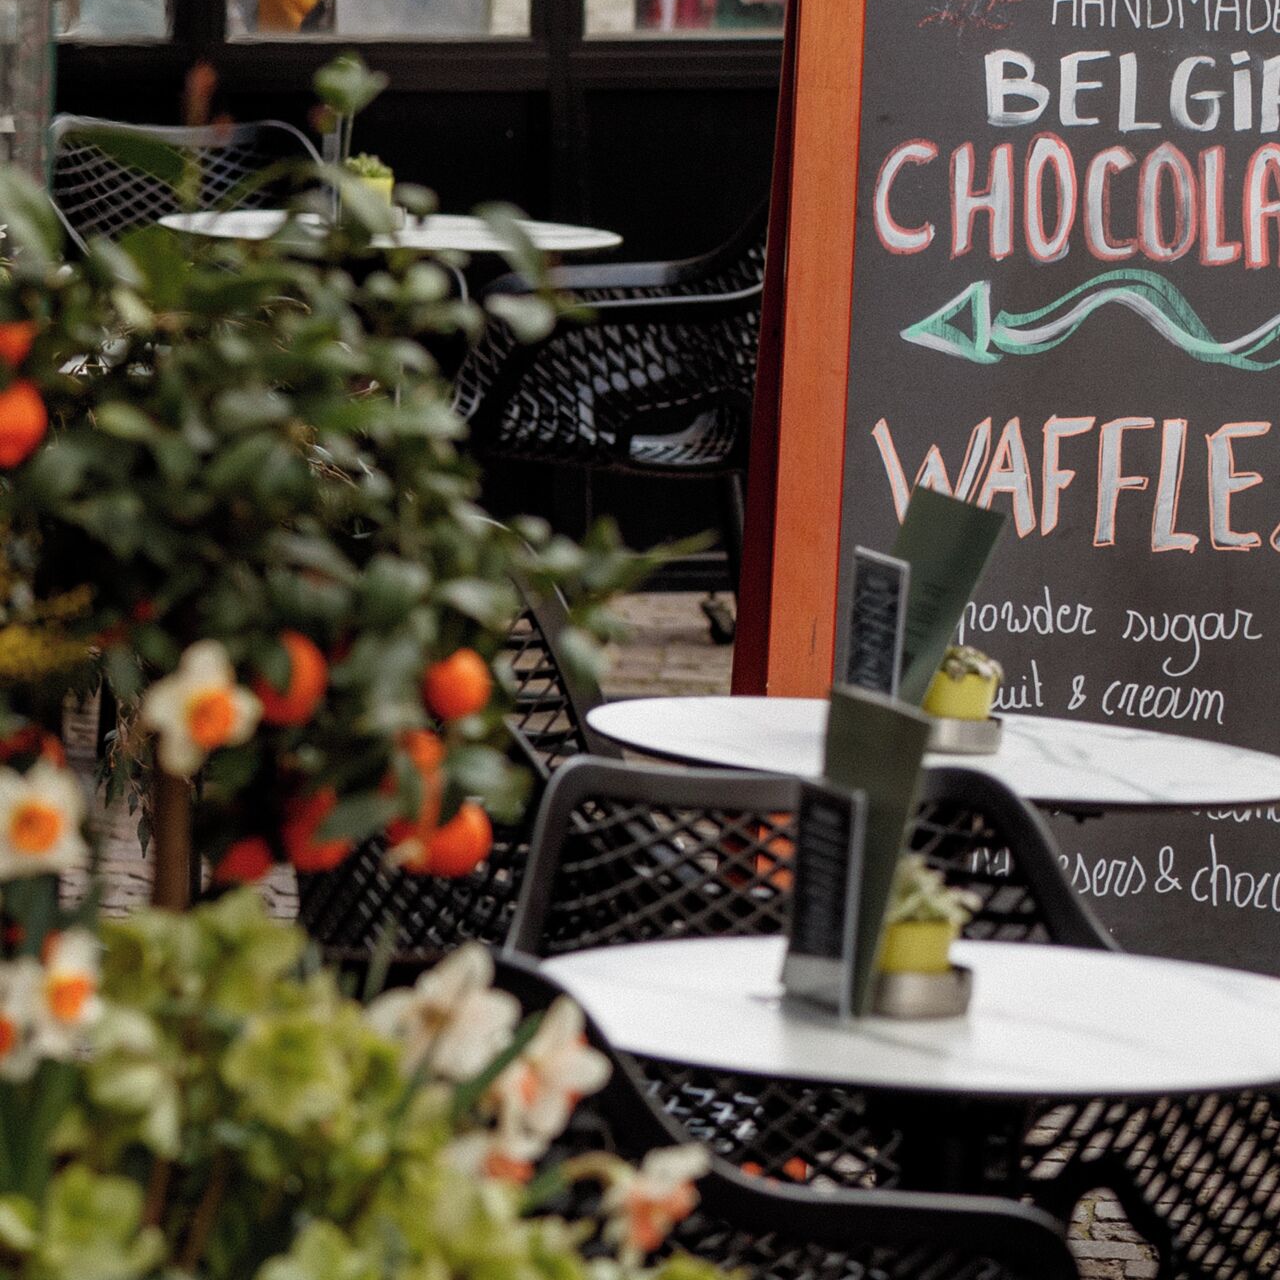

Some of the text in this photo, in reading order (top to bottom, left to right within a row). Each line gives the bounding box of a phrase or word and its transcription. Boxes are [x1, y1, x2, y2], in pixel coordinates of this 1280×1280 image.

[1121, 608, 1263, 678] sugar
[1100, 681, 1224, 725] cream
[1153, 845, 1183, 894] &
